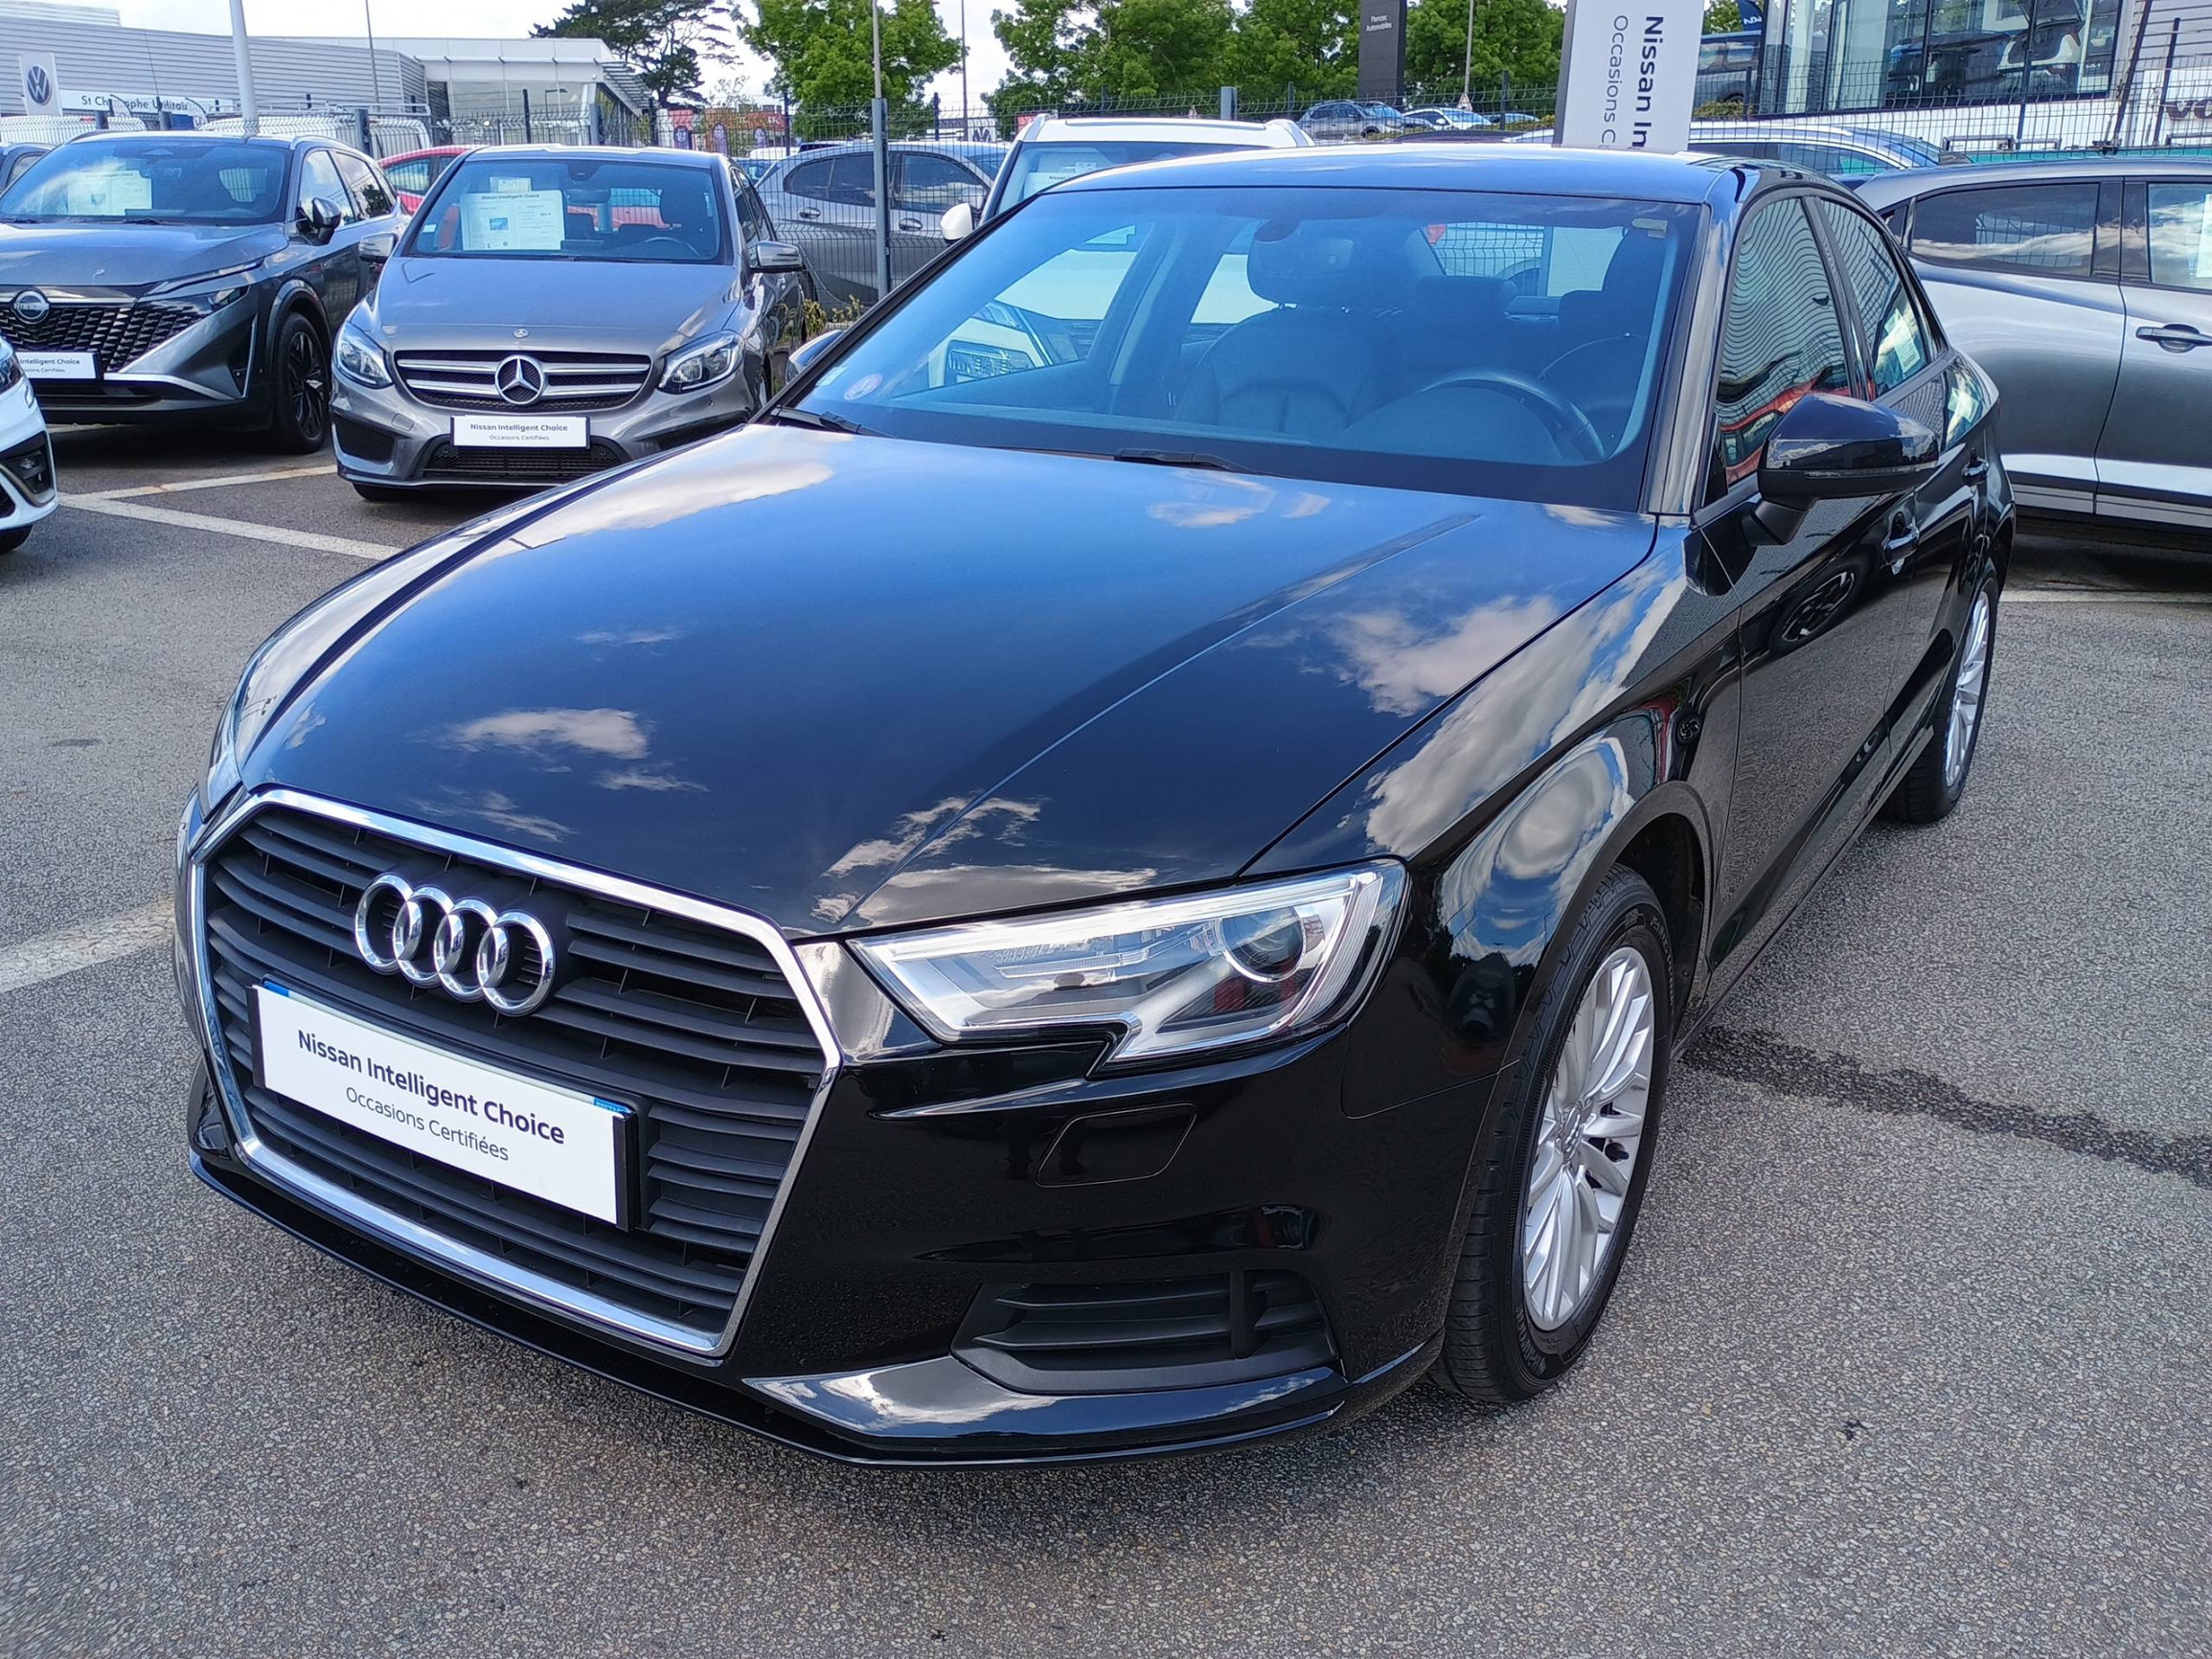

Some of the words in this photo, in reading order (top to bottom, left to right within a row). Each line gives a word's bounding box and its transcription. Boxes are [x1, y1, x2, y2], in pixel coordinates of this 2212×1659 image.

[81, 95, 92, 105] St
[1603, 14, 1630, 124] Occasions
[1634, 15, 1665, 113] Nissan
[1629, 122, 1652, 149] In
[540, 423, 568, 432] Choice
[298, 1030, 362, 1073] Nissan
[367, 1057, 478, 1117] Intelligent
[483, 1101, 565, 1145] Choice
[346, 1086, 425, 1131] Occasions
[428, 1119, 510, 1161] Certifiées
